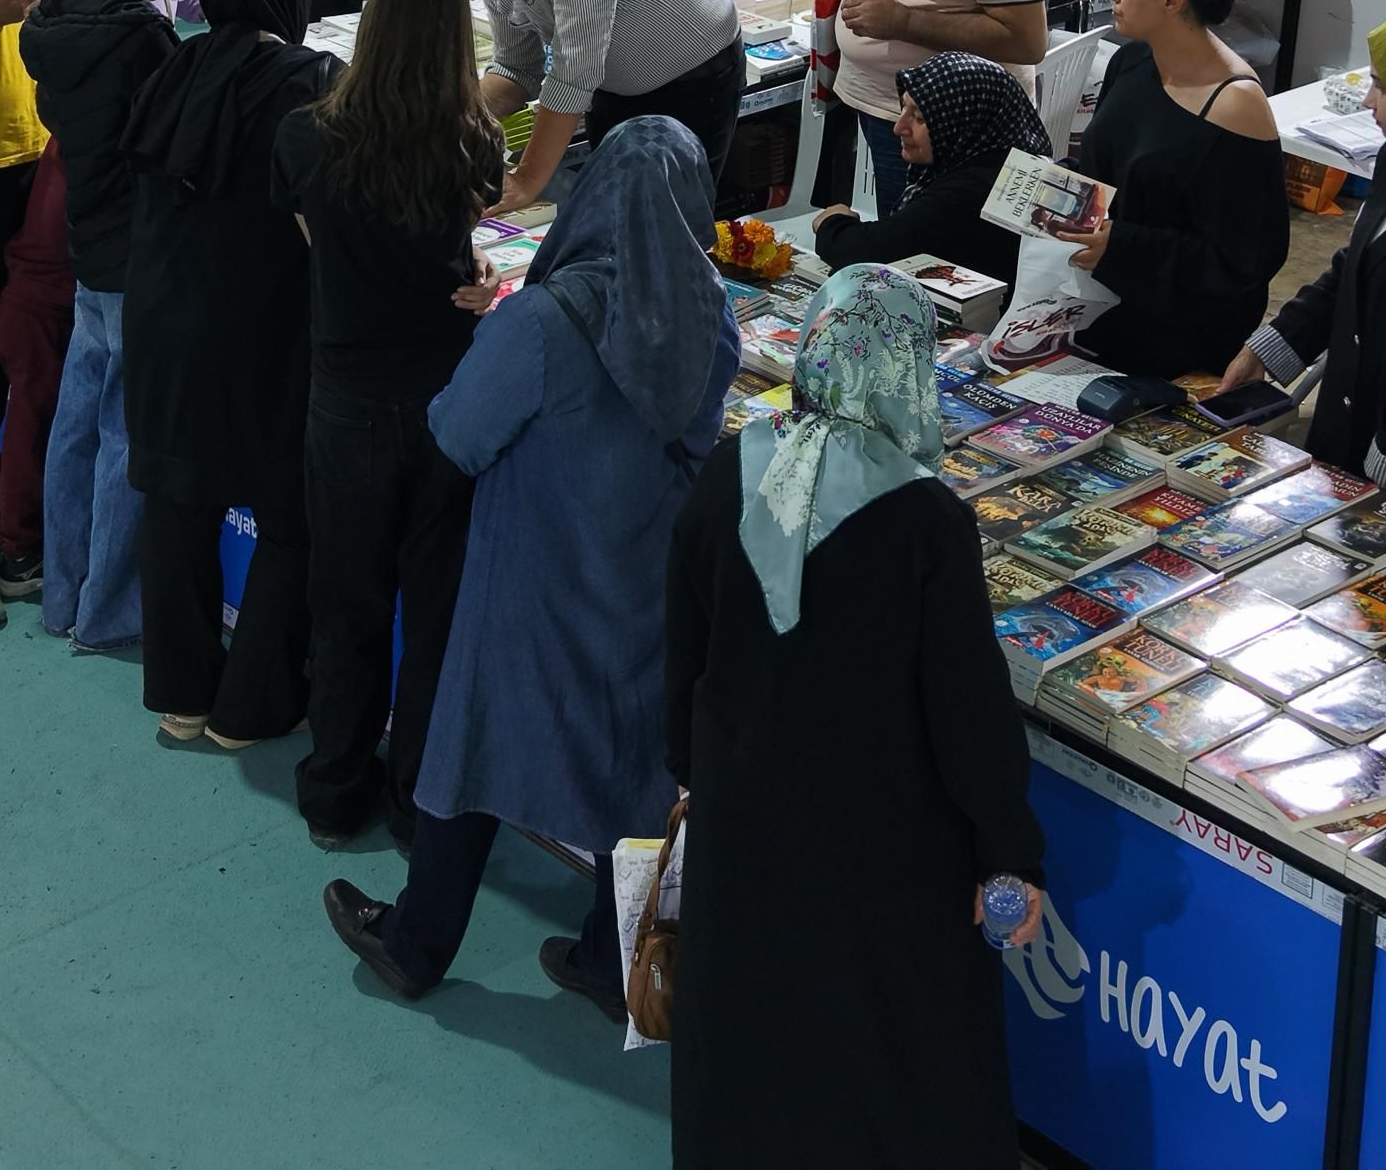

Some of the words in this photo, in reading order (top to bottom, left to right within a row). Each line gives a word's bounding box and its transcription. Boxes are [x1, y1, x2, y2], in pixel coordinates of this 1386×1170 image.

[1012, 165, 1043, 219] BEKLERKEN
[1040, 404, 1103, 432] UZAYLILAR
[1169, 807, 1274, 875] SARAY
